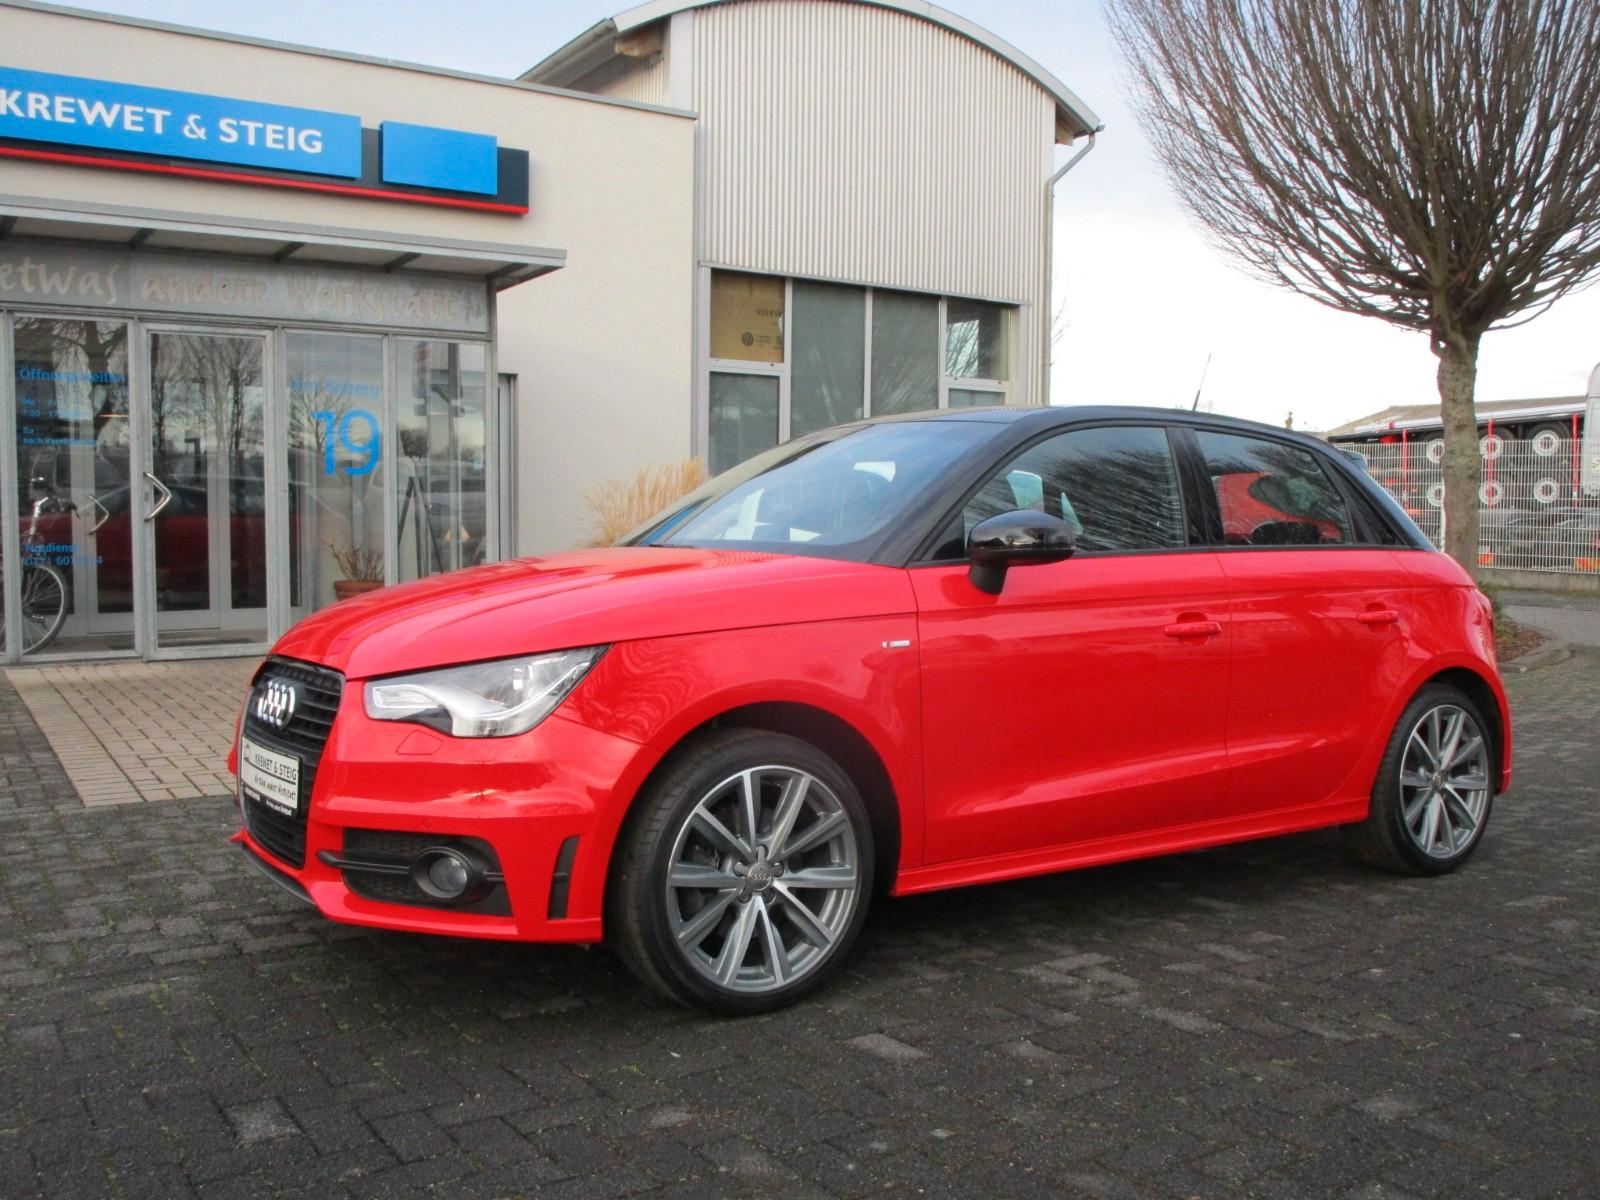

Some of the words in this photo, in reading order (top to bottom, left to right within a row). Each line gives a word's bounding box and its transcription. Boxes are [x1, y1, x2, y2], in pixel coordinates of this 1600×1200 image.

[0, 89, 171, 135] KREWET
[182, 114, 207, 140] &
[218, 117, 323, 154] STEIG
[311, 409, 381, 476] 19
[279, 763, 297, 781] STEIG
